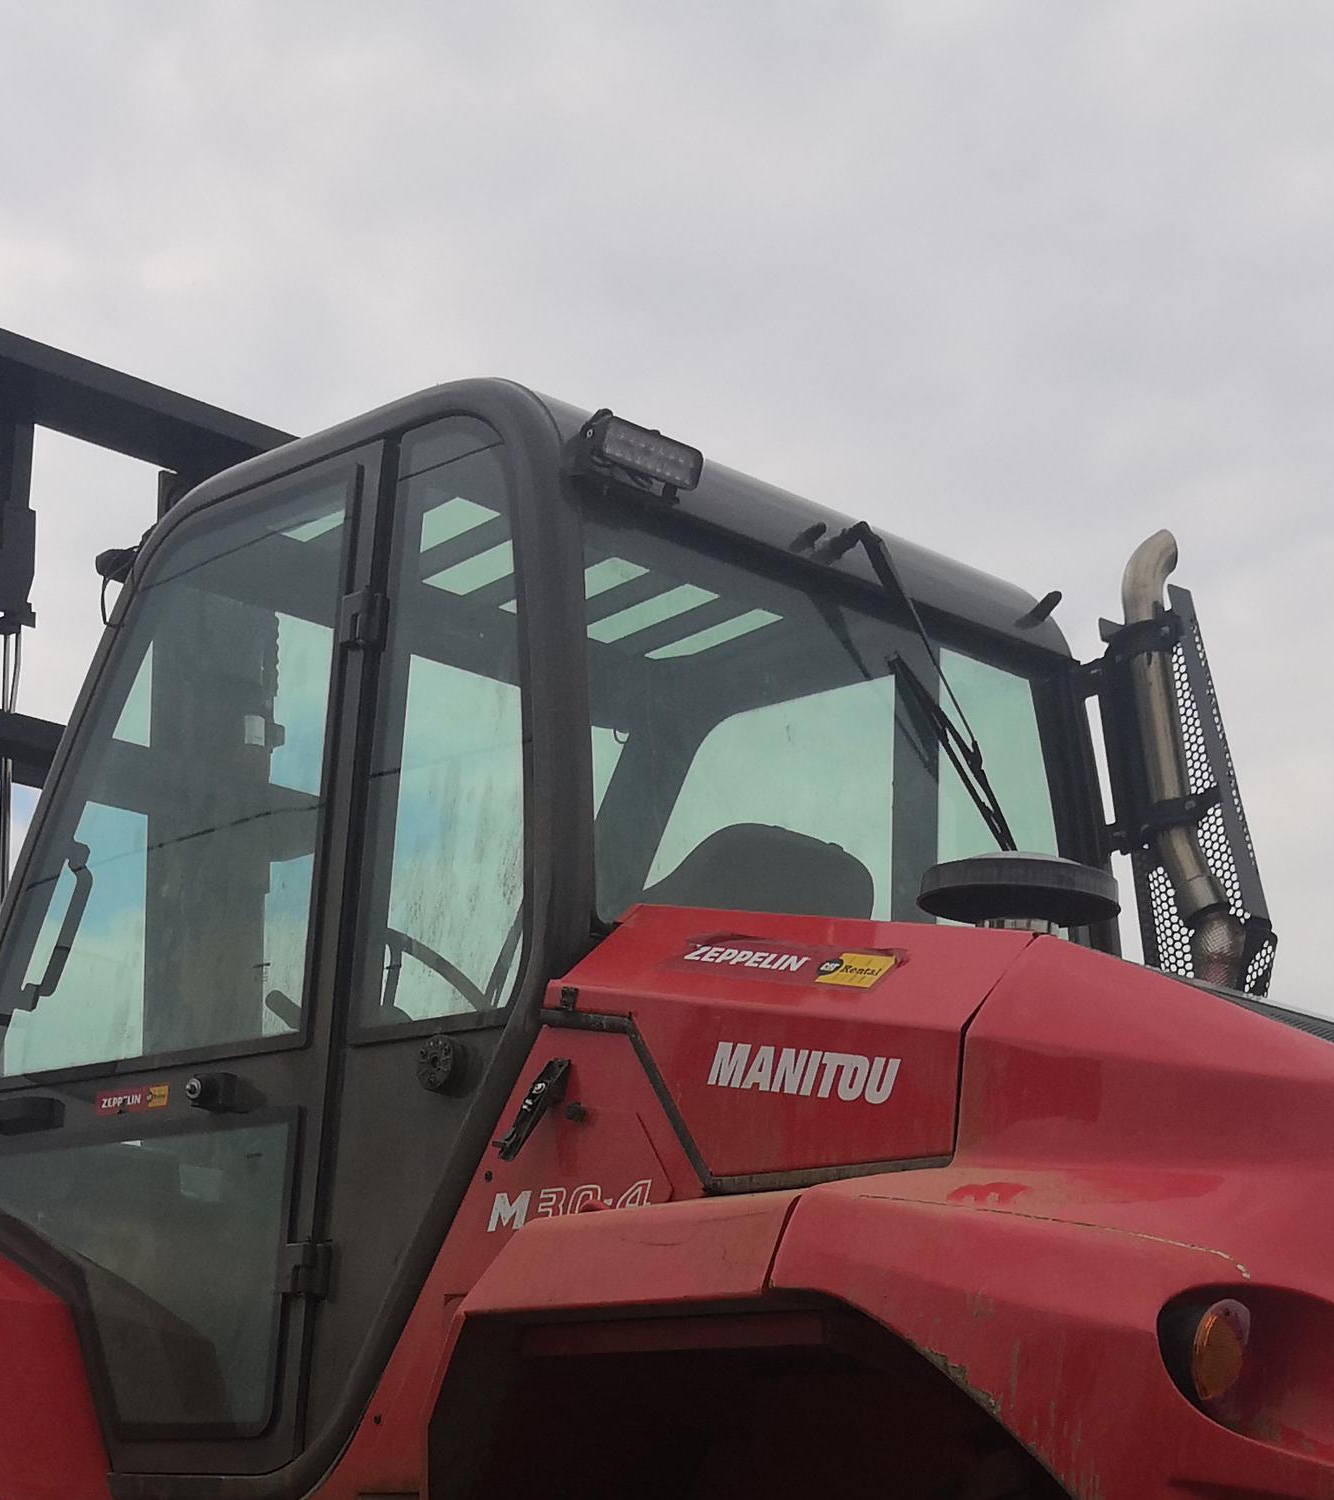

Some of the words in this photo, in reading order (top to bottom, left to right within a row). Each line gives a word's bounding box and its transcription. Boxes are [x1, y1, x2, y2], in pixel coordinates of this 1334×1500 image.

[684, 944, 812, 972] ZEPPELIN
[842, 965, 882, 976] Rental
[707, 1041, 902, 1105] MANITOU
